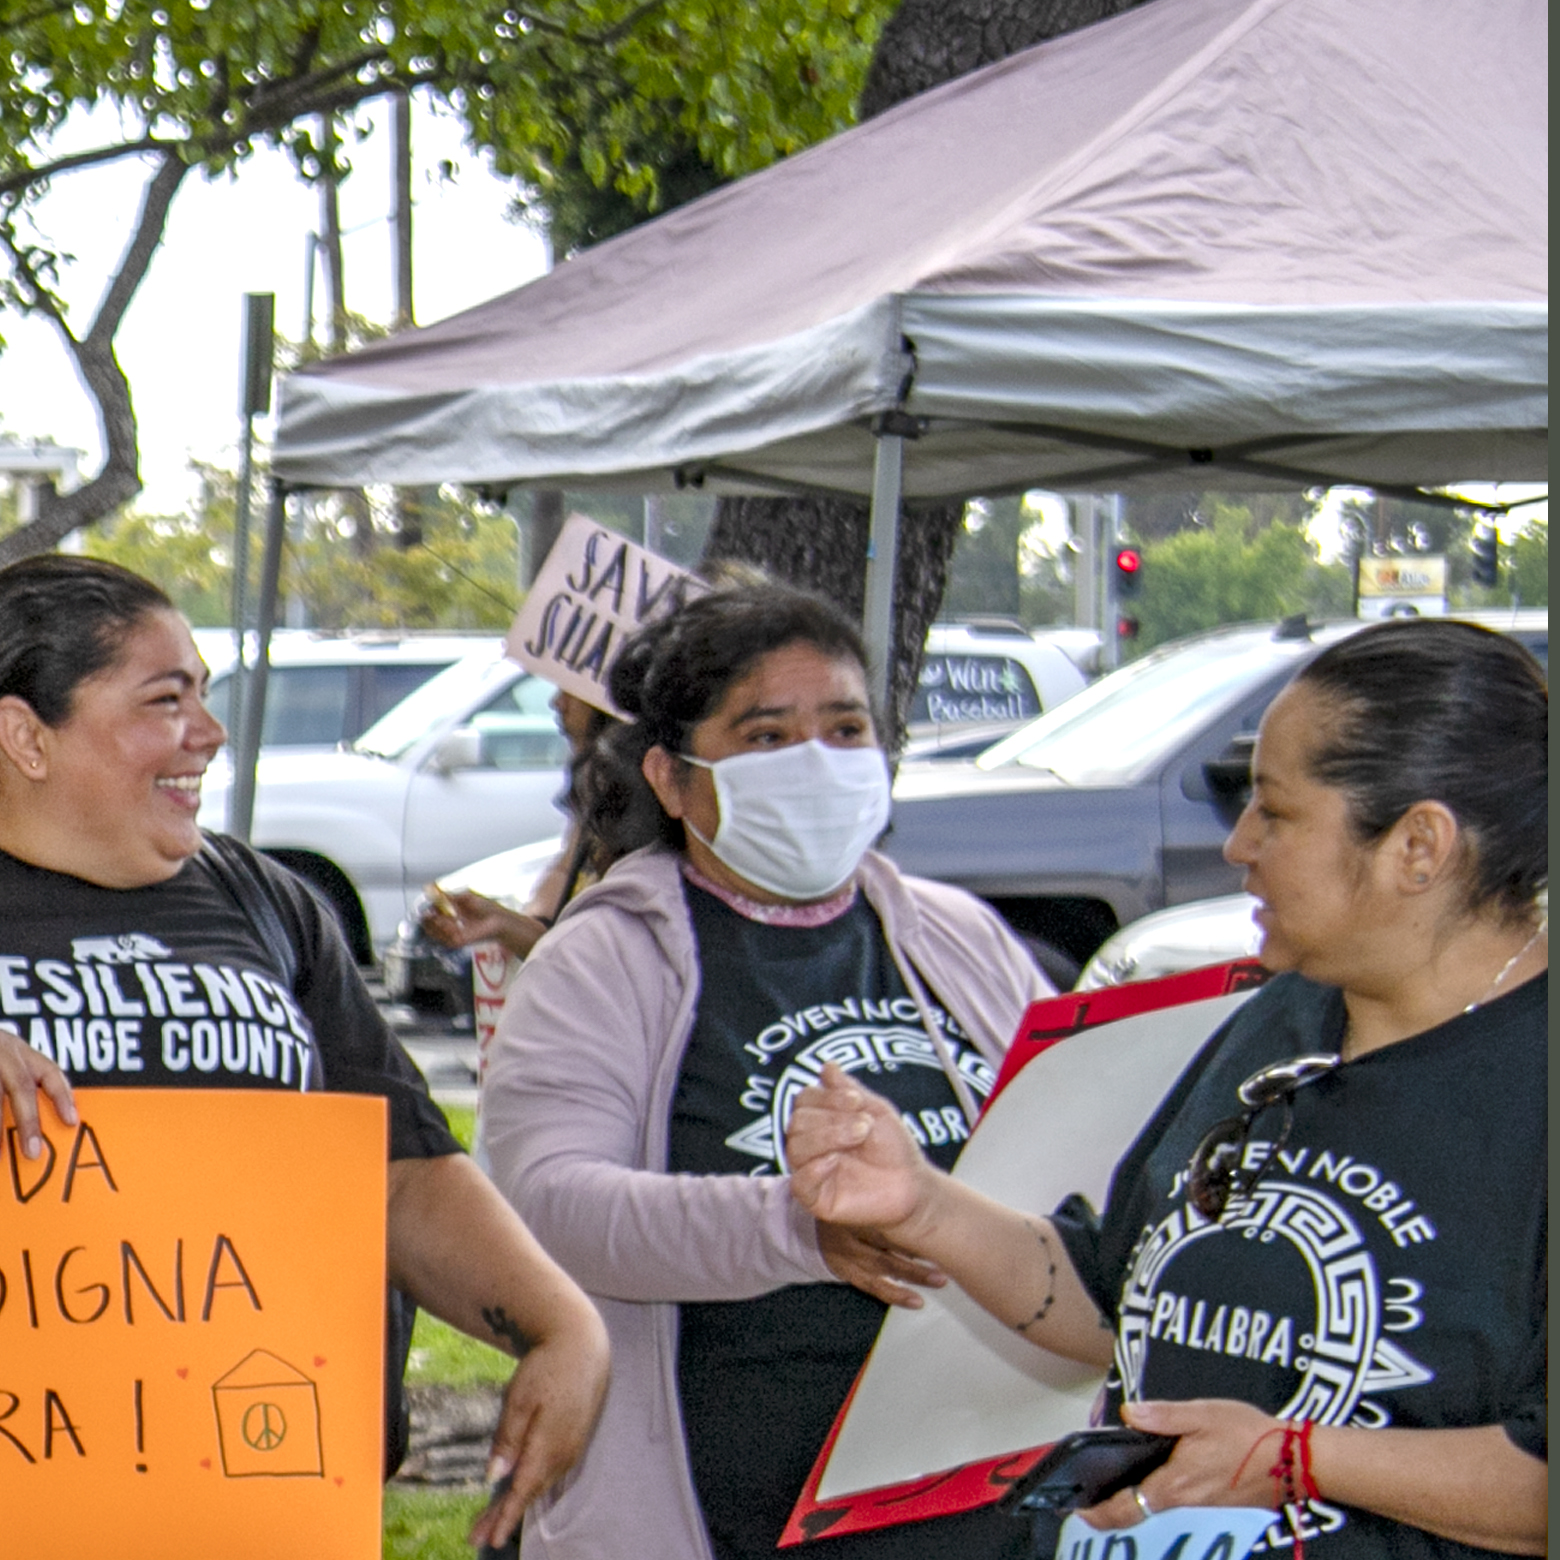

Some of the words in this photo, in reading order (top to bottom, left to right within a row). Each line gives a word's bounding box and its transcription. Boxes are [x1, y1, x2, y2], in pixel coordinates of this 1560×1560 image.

[160, 1018, 312, 1093] COUNTY
[743, 996, 860, 1065] JOVEN
[861, 998, 970, 1040] NOBL
[1307, 1150, 1437, 1249] NOBLE
[1149, 1290, 1293, 1368] PALABRA
